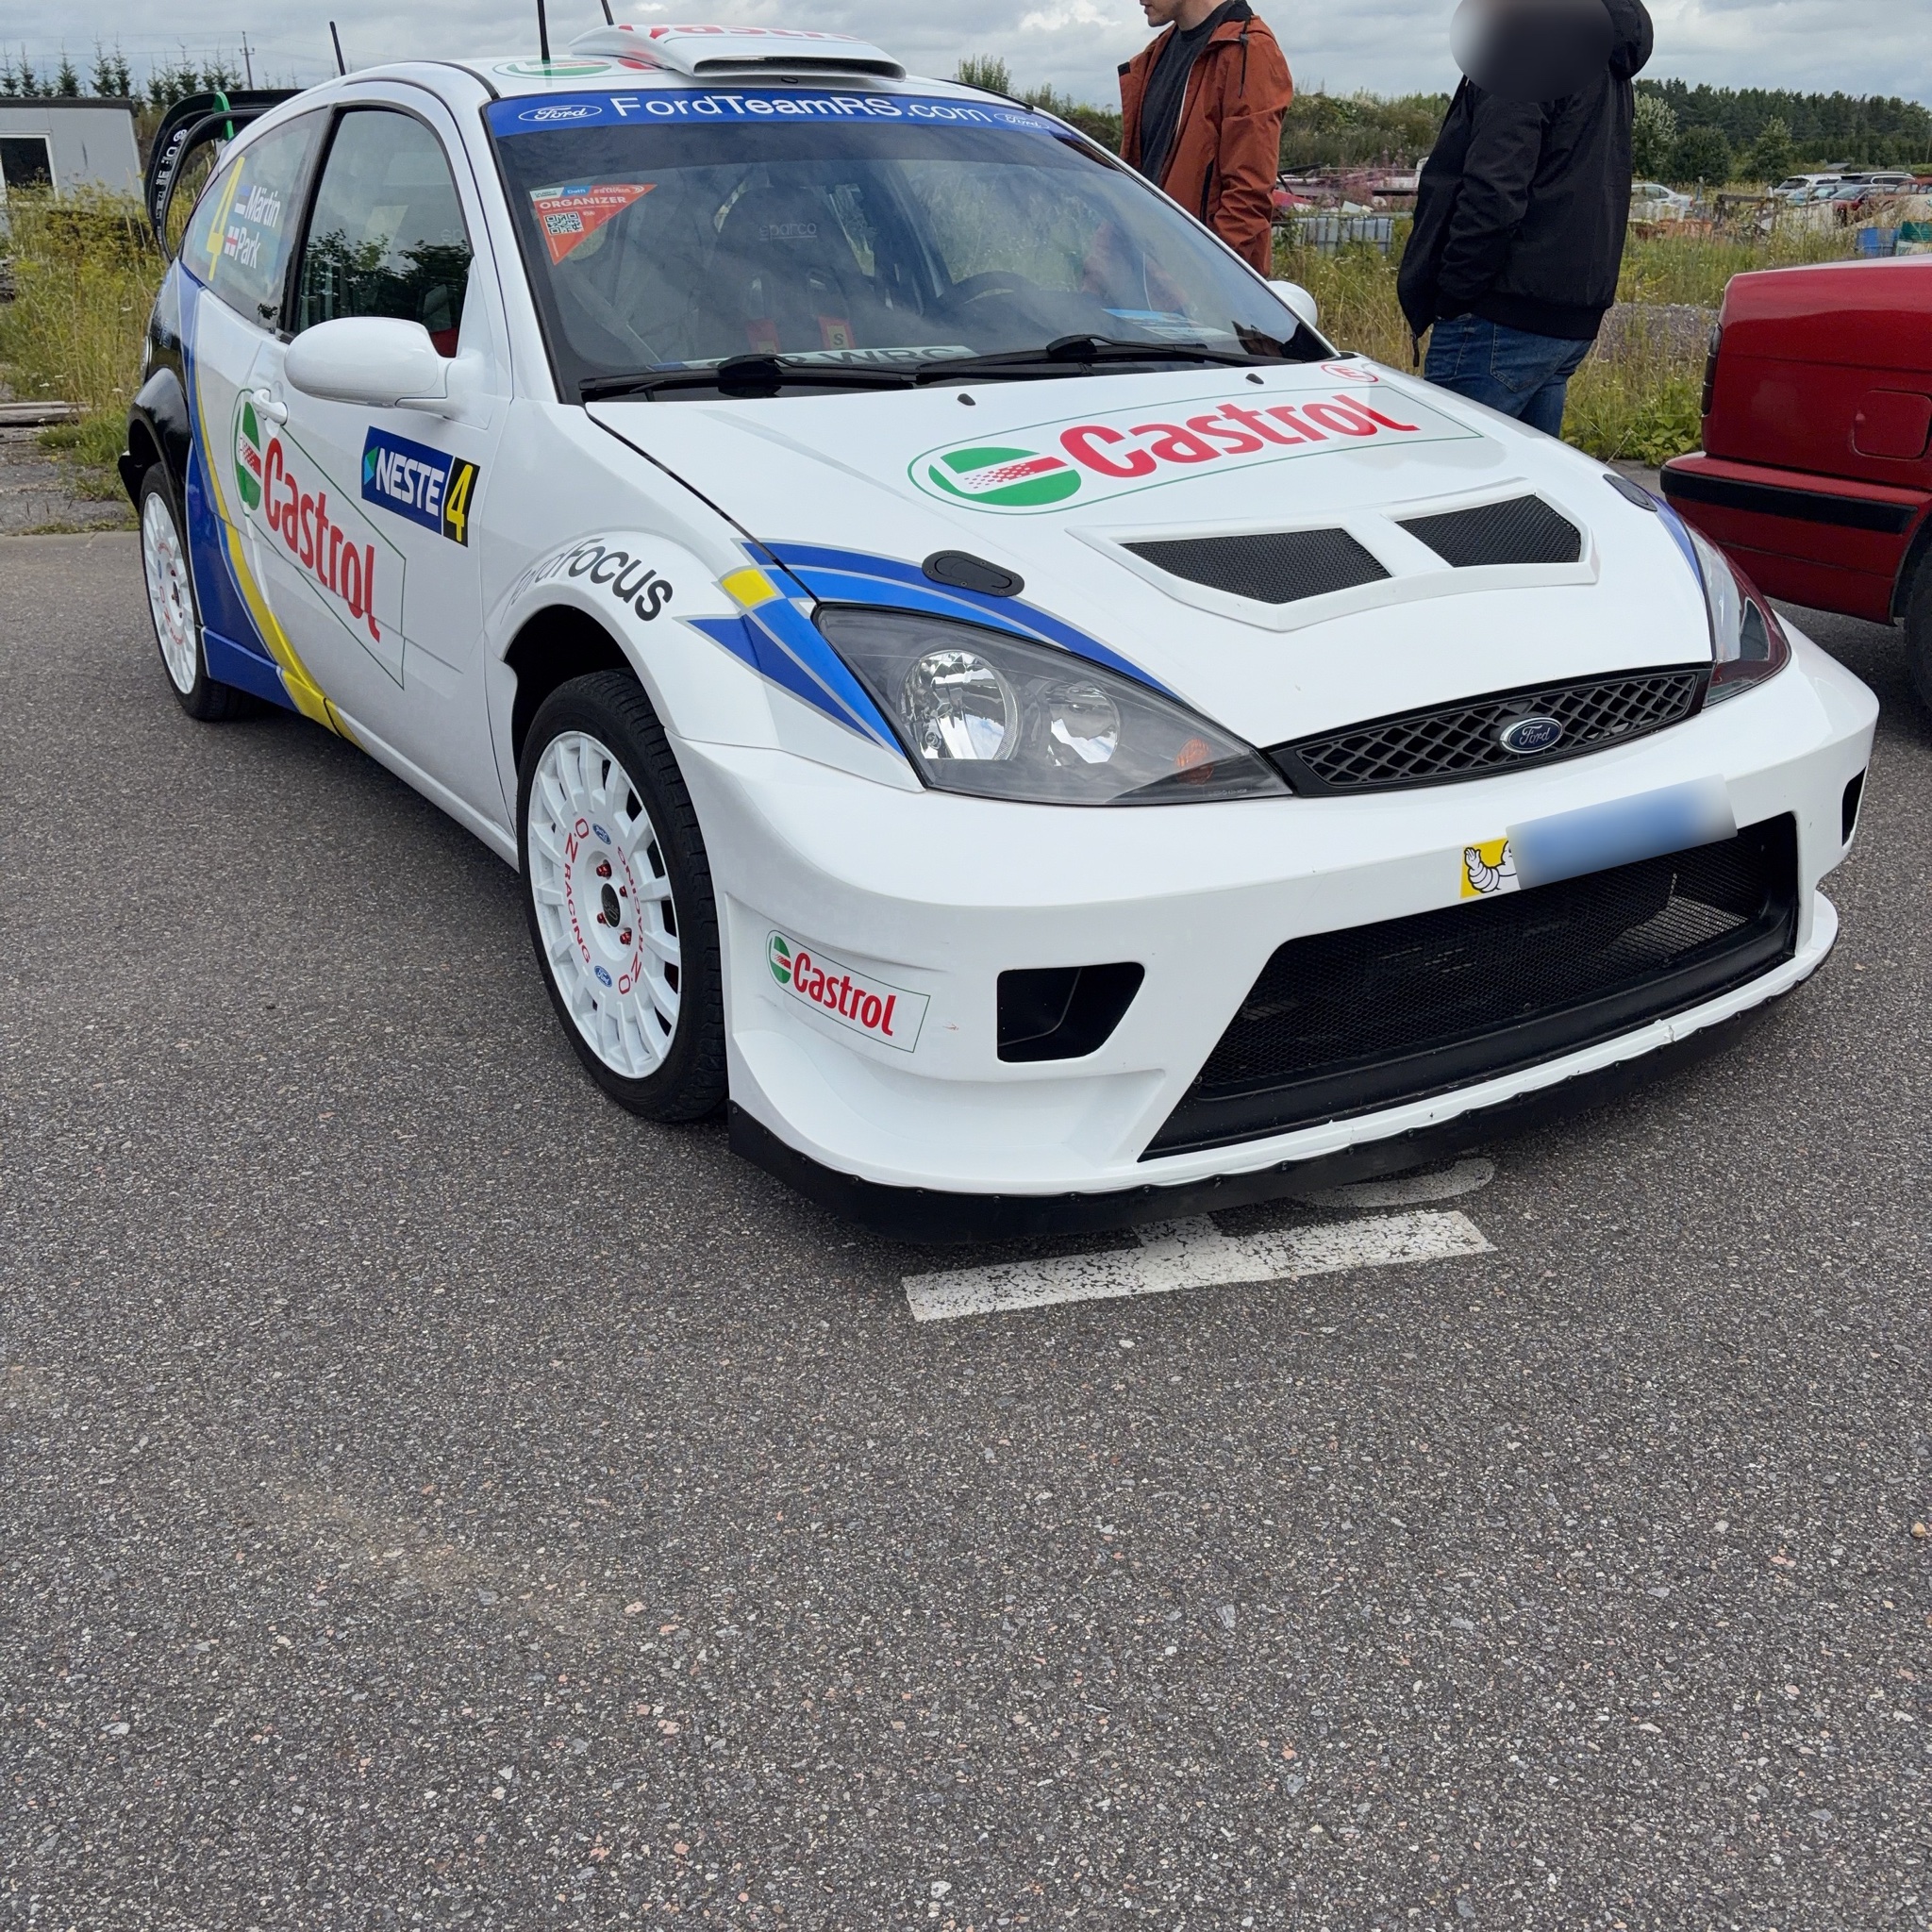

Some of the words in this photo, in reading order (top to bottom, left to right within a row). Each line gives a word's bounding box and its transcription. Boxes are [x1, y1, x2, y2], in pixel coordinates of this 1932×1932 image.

[608, 95, 993, 123] FordTeamRS.com
[207, 157, 246, 281] 4
[539, 196, 627, 209] ORGANIZER
[234, 226, 261, 269] Park
[1059, 393, 1421, 477] Castrol
[375, 447, 446, 514] NESTE
[446, 464, 474, 542] 4
[263, 437, 381, 643] Castrol
[564, 862, 591, 964] RACING
[793, 952, 897, 1037] Castrol
